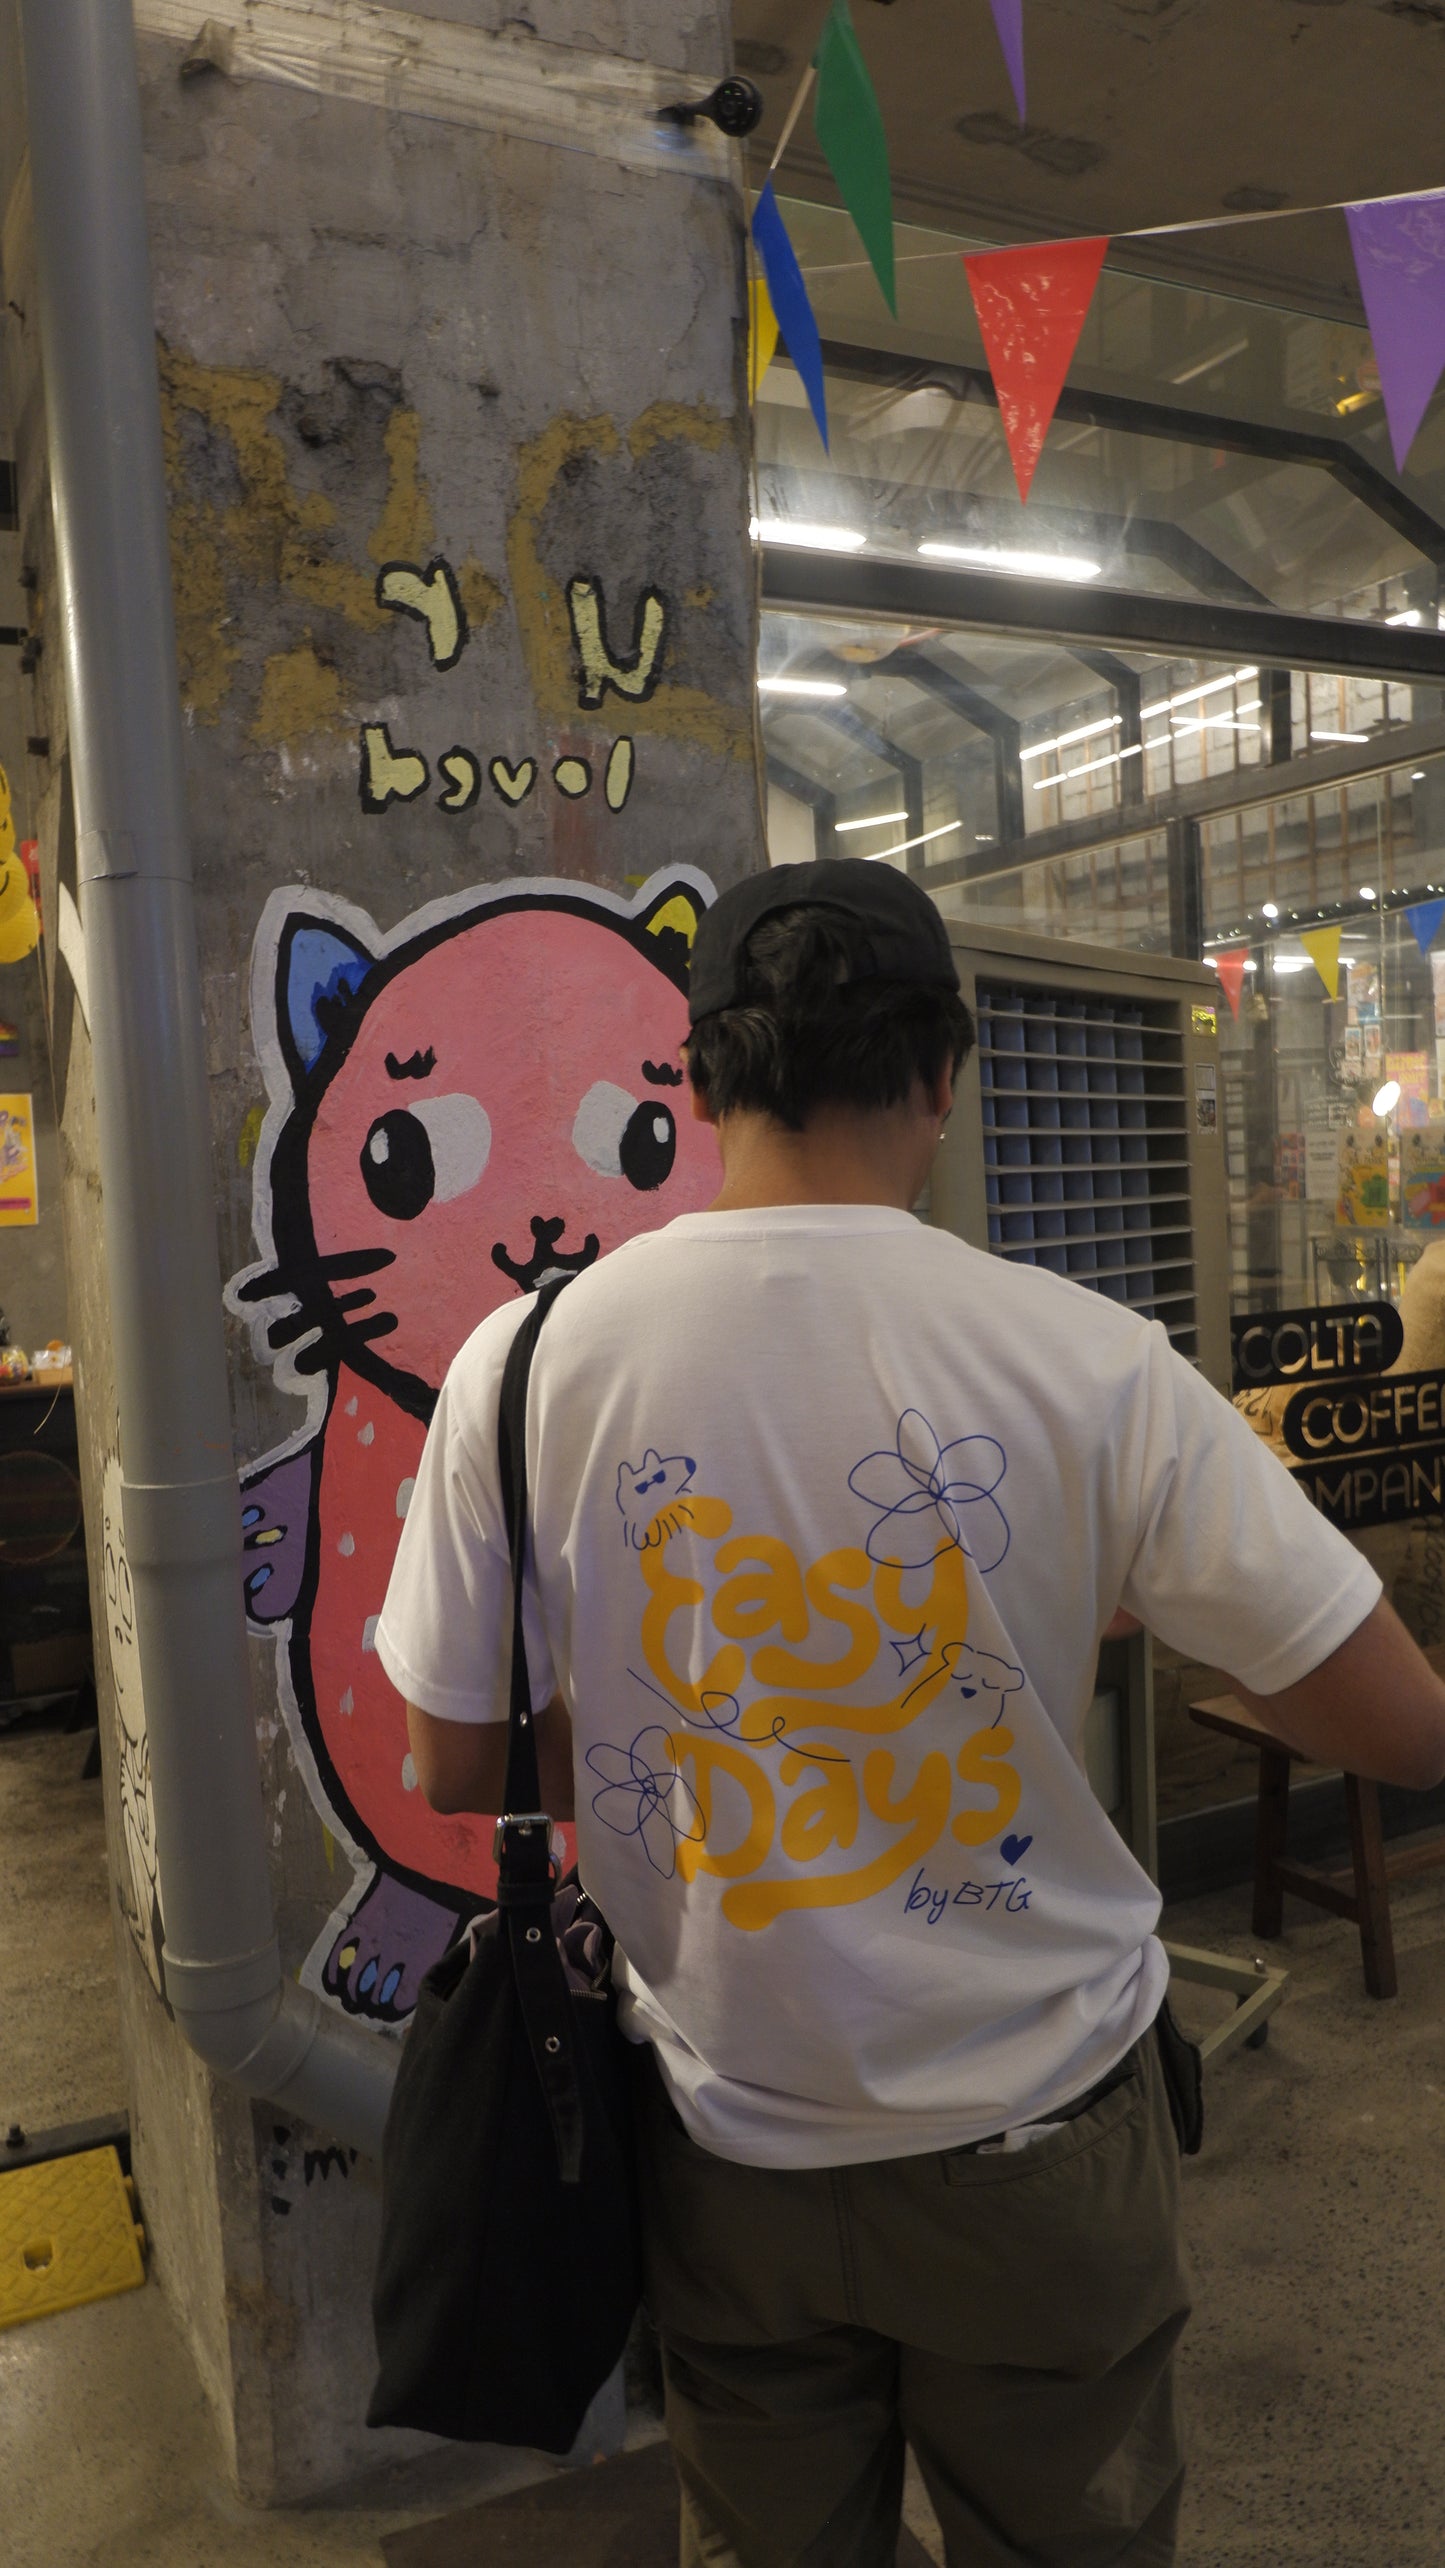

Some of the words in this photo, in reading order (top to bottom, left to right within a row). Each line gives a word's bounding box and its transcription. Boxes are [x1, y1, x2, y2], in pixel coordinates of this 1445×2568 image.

[1231, 1313, 1383, 1379] COLTA
[1301, 1381, 1445, 1449] COFFE
[1296, 1456, 1445, 1520] MPAN
[640, 1496, 968, 1749] Easy
[664, 1725, 1021, 1932] Days
